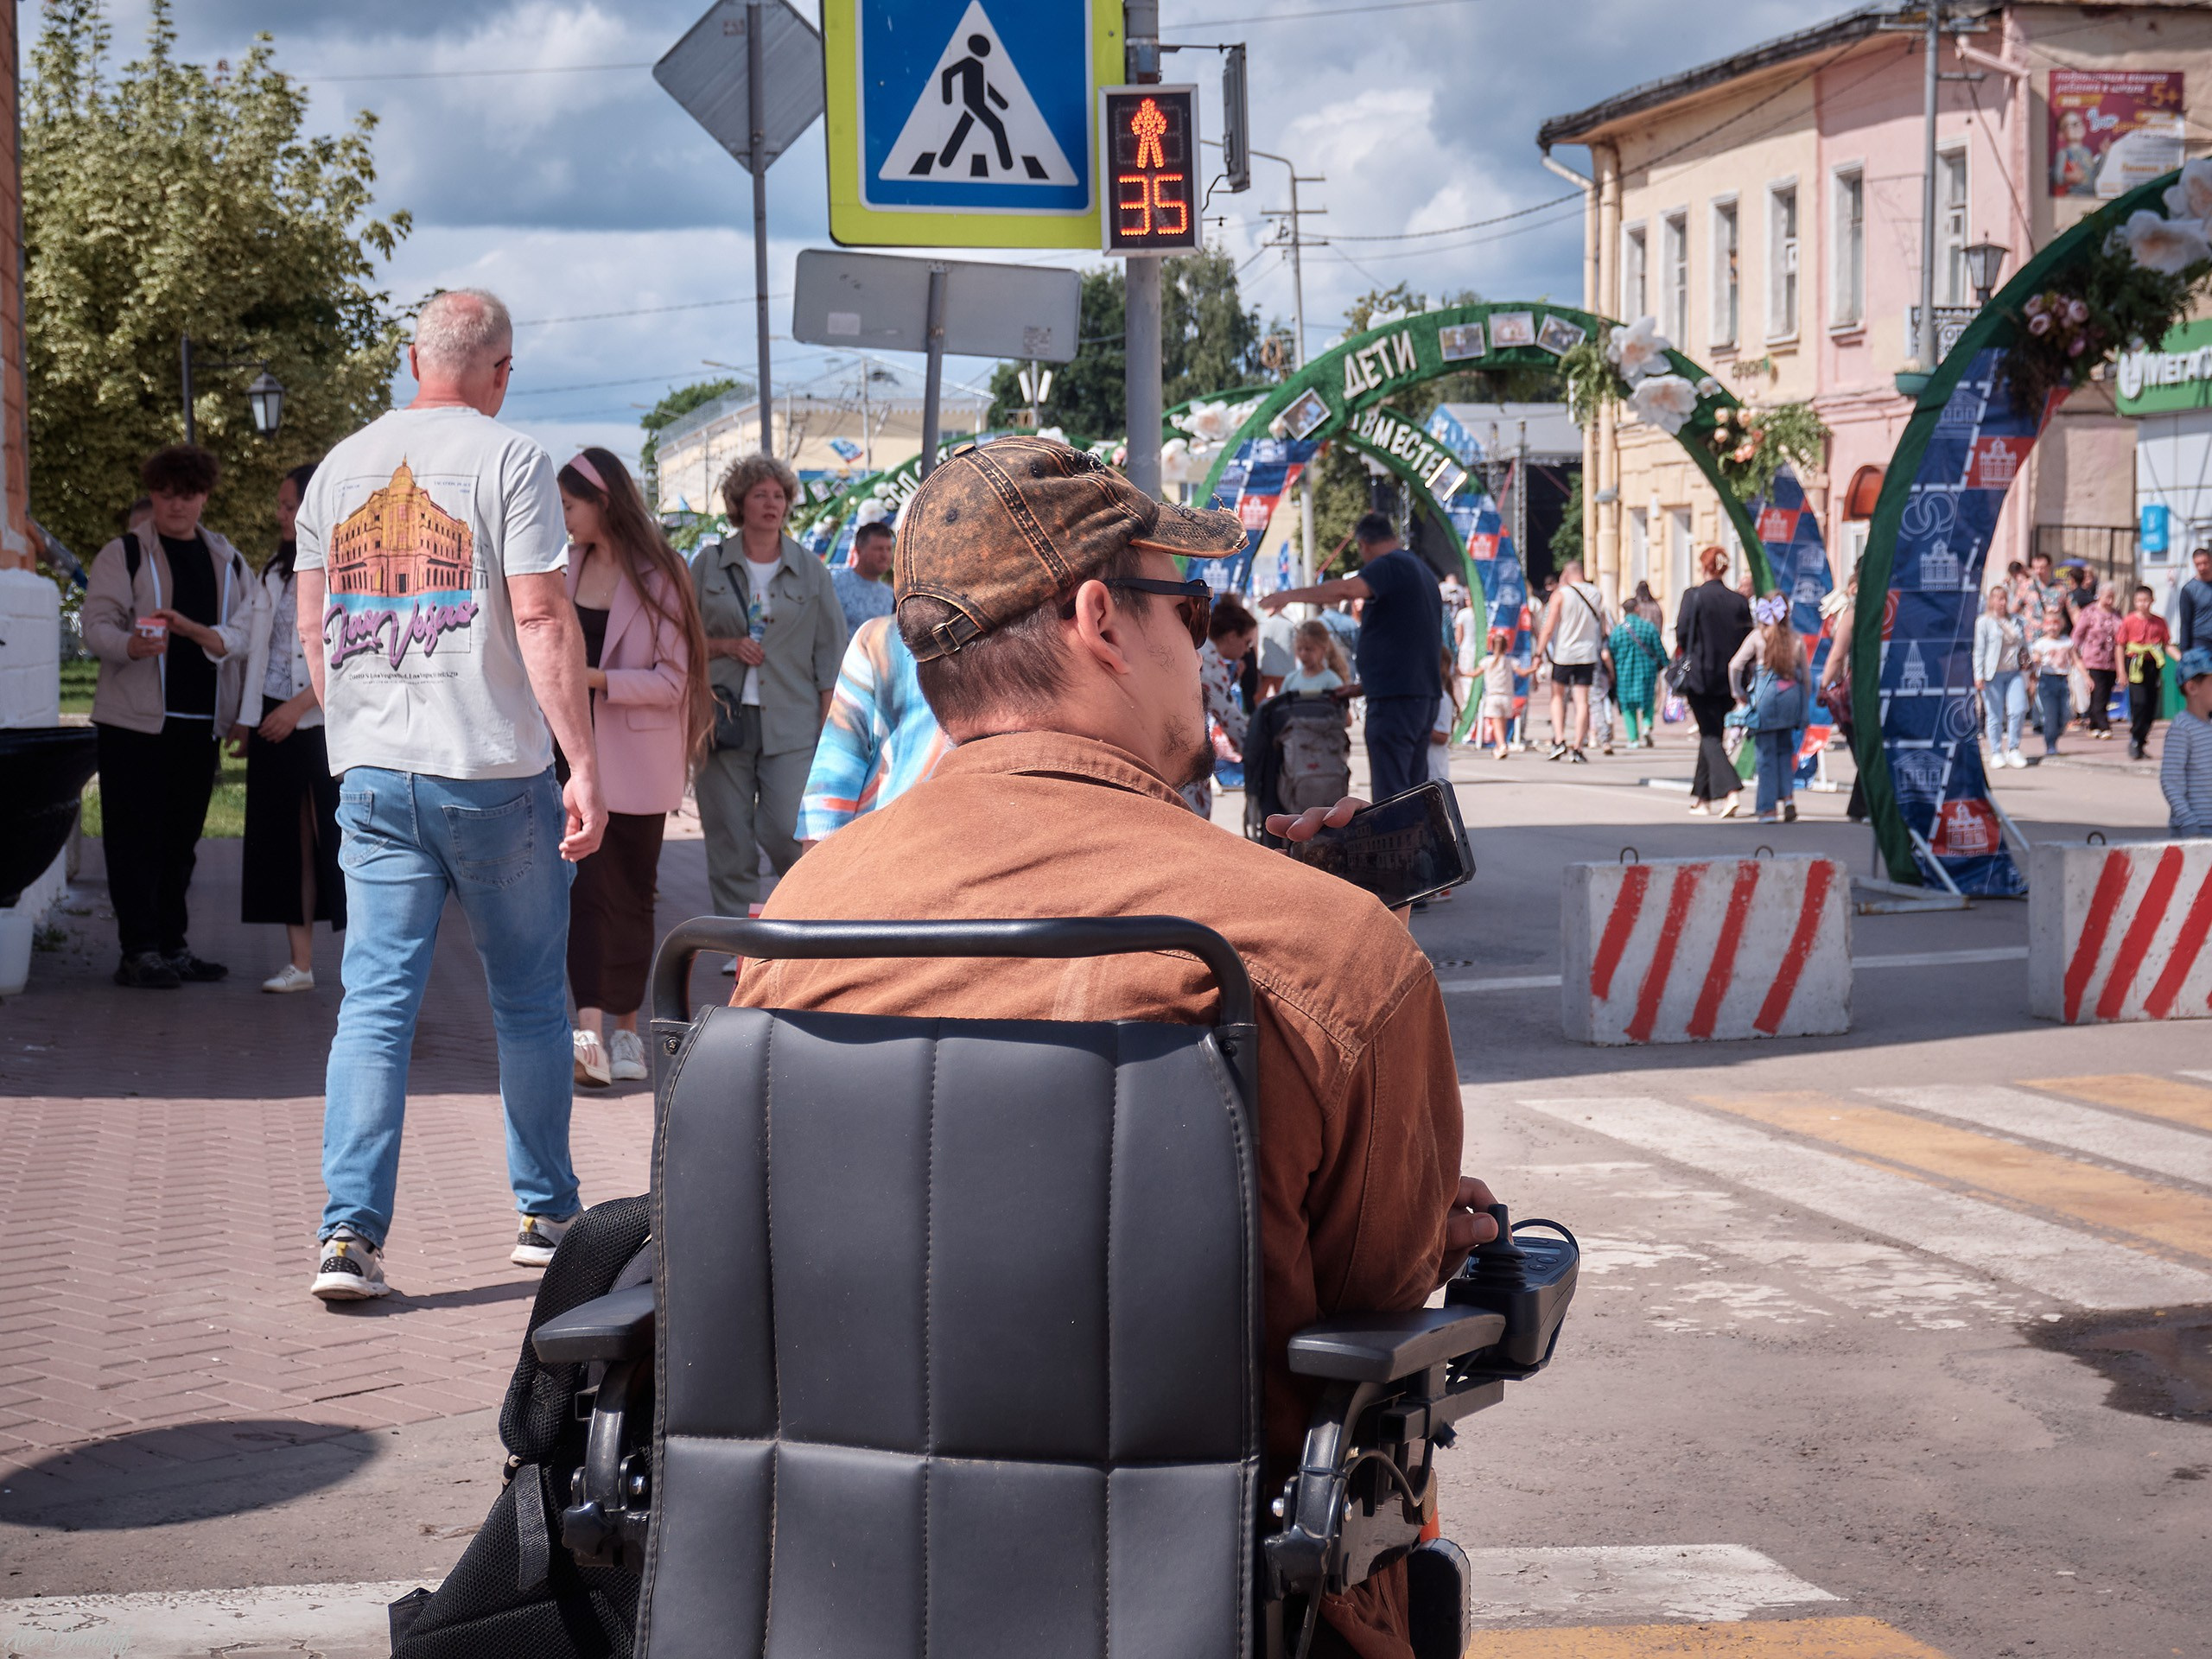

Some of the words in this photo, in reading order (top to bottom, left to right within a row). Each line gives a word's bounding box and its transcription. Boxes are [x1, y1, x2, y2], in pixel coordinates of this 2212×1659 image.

[1119, 174, 1188, 237] 35
[1343, 329, 1418, 401] ДЕТИ
[322, 603, 381, 670] Las
[372, 599, 479, 671] Vegas
